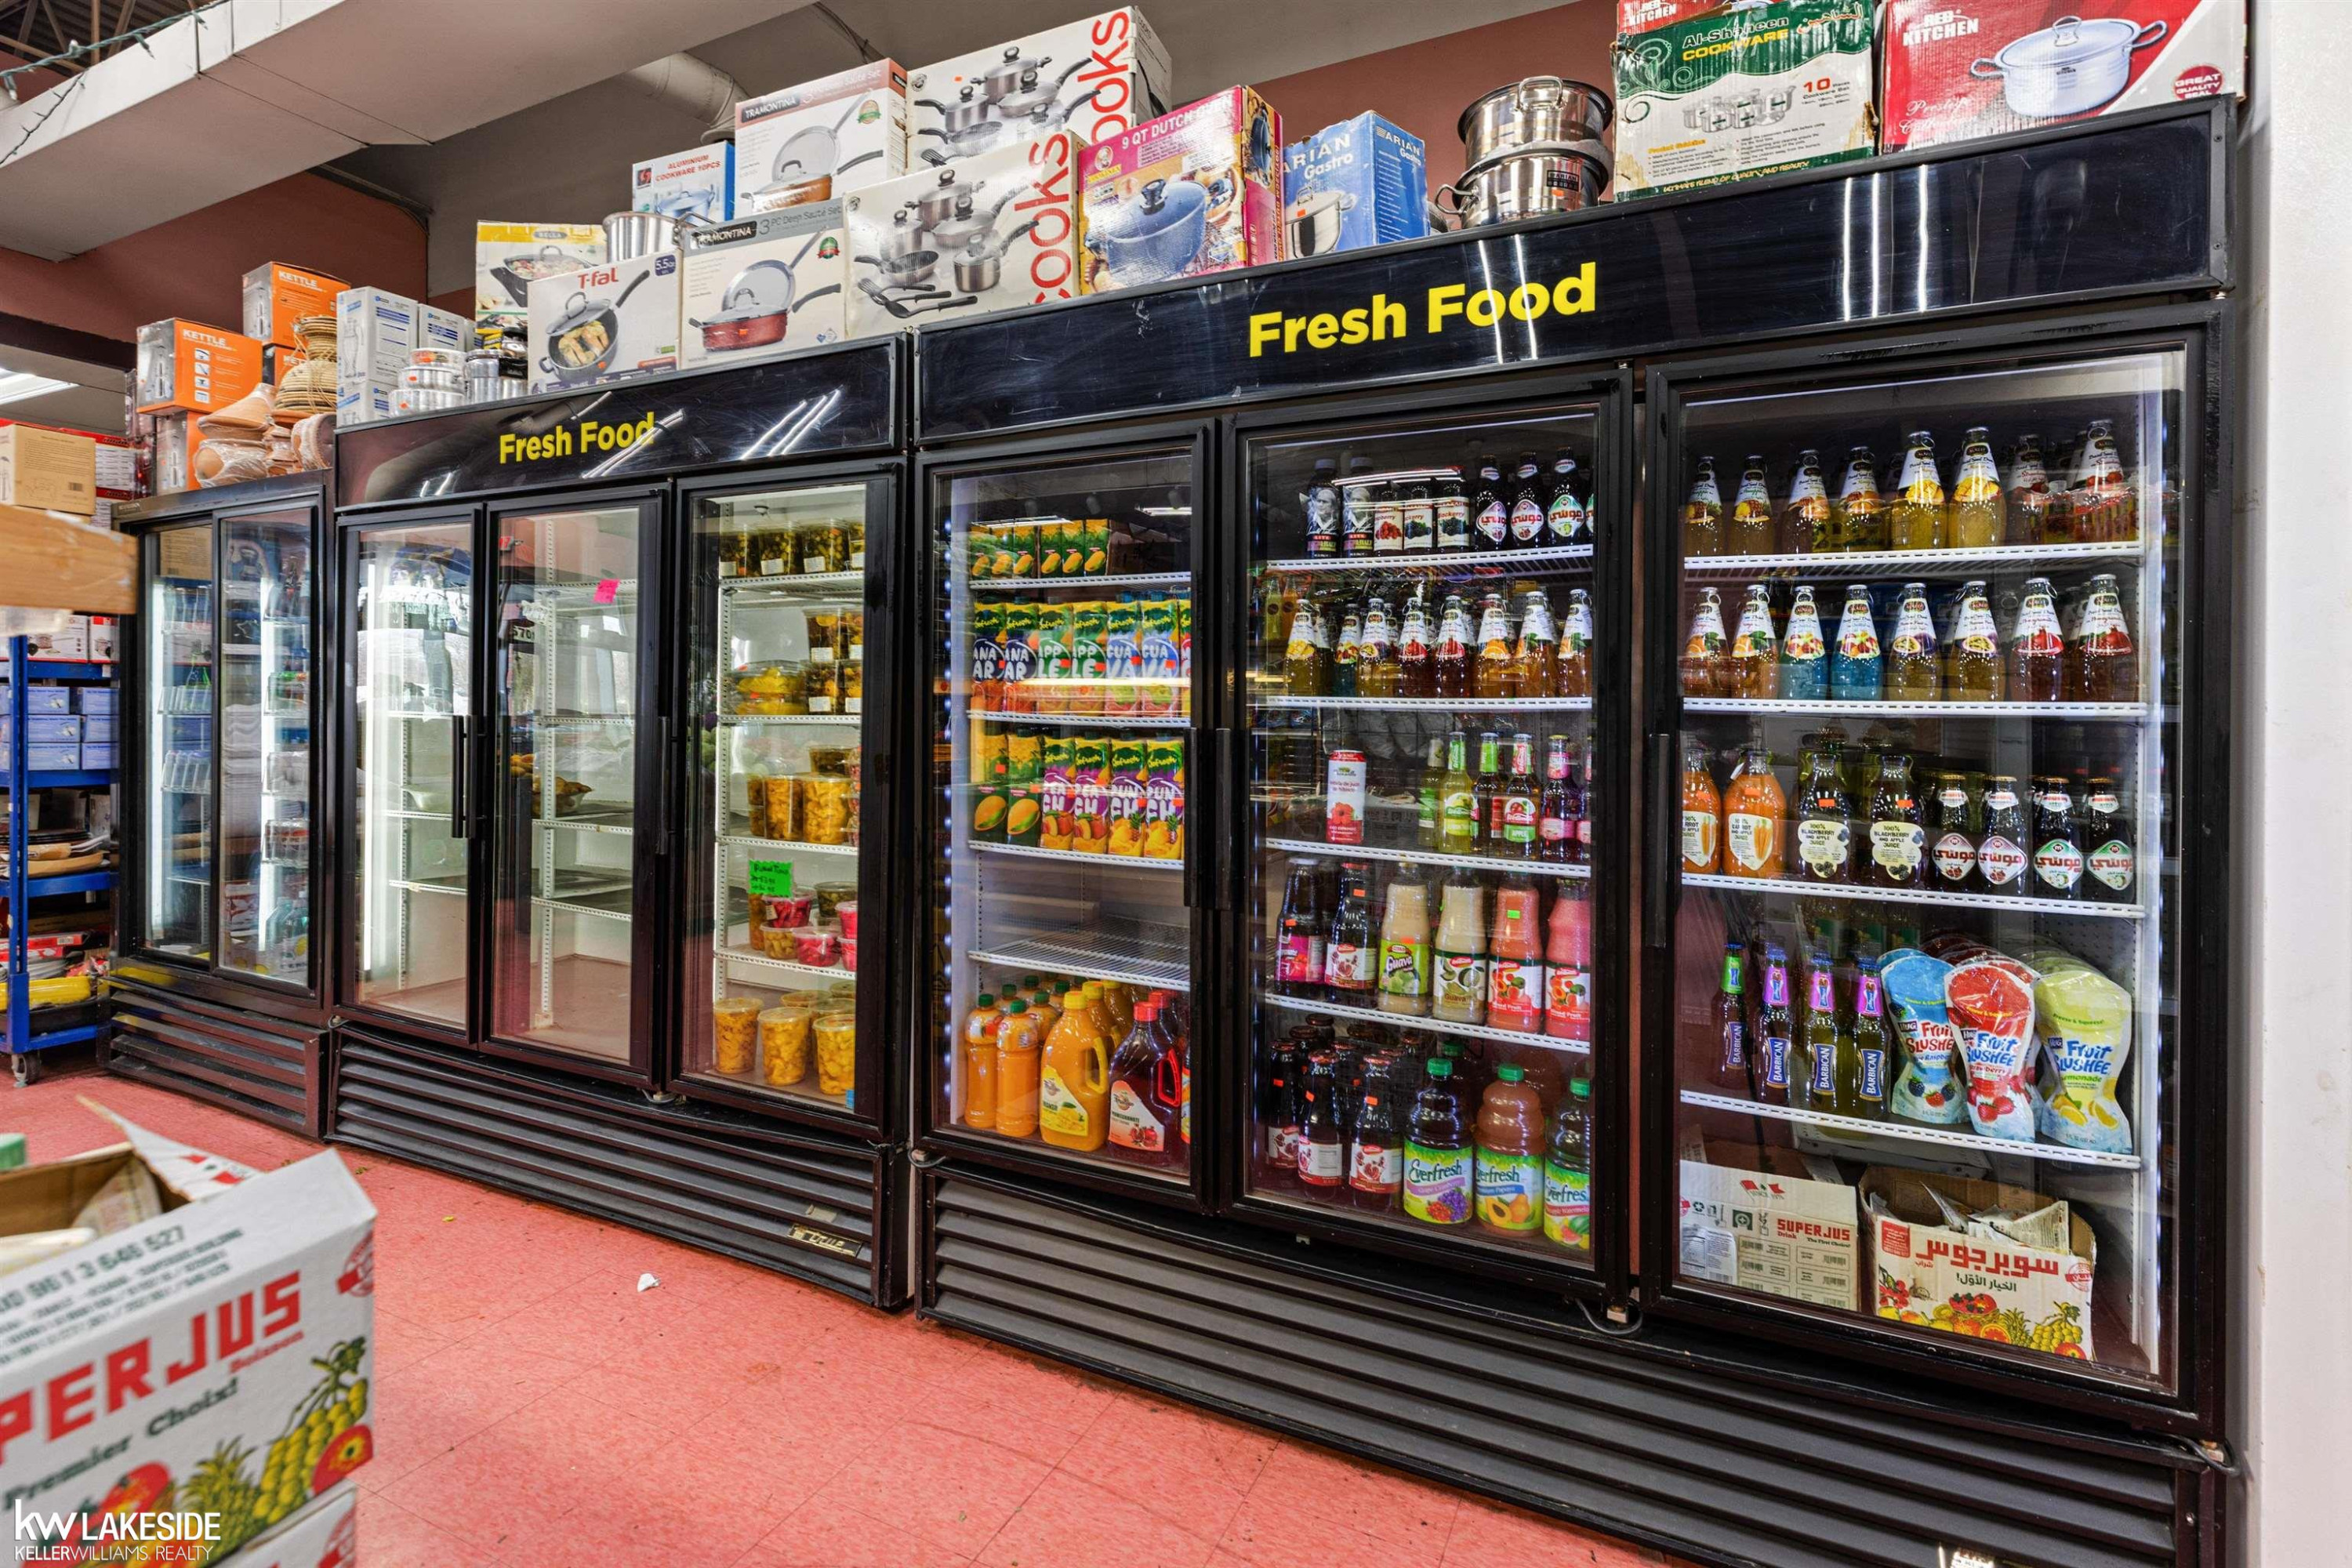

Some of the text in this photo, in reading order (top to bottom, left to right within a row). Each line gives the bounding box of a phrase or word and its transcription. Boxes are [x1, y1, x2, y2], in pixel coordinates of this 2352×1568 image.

[1682, 16, 1789, 49] Al-Shaheen
[1903, 18, 1979, 47] KITCHEN
[1682, 28, 1789, 61] COOKWARE
[1076, 11, 1130, 143] ooks
[1803, 77, 1831, 93] 10
[2174, 73, 2220, 87] GREAT
[2176, 82, 2220, 95] QUALITY
[746, 96, 797, 118] TRAMONTINA
[1121, 137, 1130, 149] 9
[1132, 129, 1149, 145] QT
[1151, 111, 1191, 140] DUTCH
[1284, 133, 1350, 173] ARIAN
[1385, 132, 1421, 155] ARIAN
[668, 154, 709, 170] ALUMINIUM
[1305, 152, 1353, 180] Gastro
[1399, 148, 1421, 166] Gastro
[655, 166, 696, 182] COOKWARE
[759, 220, 770, 235] 3
[278, 270, 318, 287] KETTLE
[1250, 262, 1596, 358] Fresh Food
[183, 328, 226, 346] KETTLE
[499, 412, 655, 464] Fresh Food
[1005, 648, 1029, 662] ANA
[1004, 661, 1027, 681] AR
[1386, 954, 1413, 971] Guava
[1445, 994, 1466, 1003] Guava
[1733, 1025, 1742, 1063] BARBICAN
[1906, 1038, 1954, 1054] SLUSHE
[1977, 1033, 2020, 1052] Fruit
[2066, 1041, 2113, 1060] Fruit
[1773, 1041, 1783, 1082] BARBICAN
[1966, 1047, 2017, 1067] SLUSHEE
[1820, 1047, 1830, 1089] BARBICAN
[1867, 1053, 1877, 1094] BARBICAN
[2061, 1074, 2102, 1083] emonade
[1410, 1158, 1462, 1183] Everfresh
[1777, 1231, 1797, 1240] Drink
[78, 1261, 96, 1279] 3
[143, 1224, 187, 1252] 527
[1989, 1276, 2016, 1292] الخيار
[5, 1377, 238, 1512] Premier Choix!
